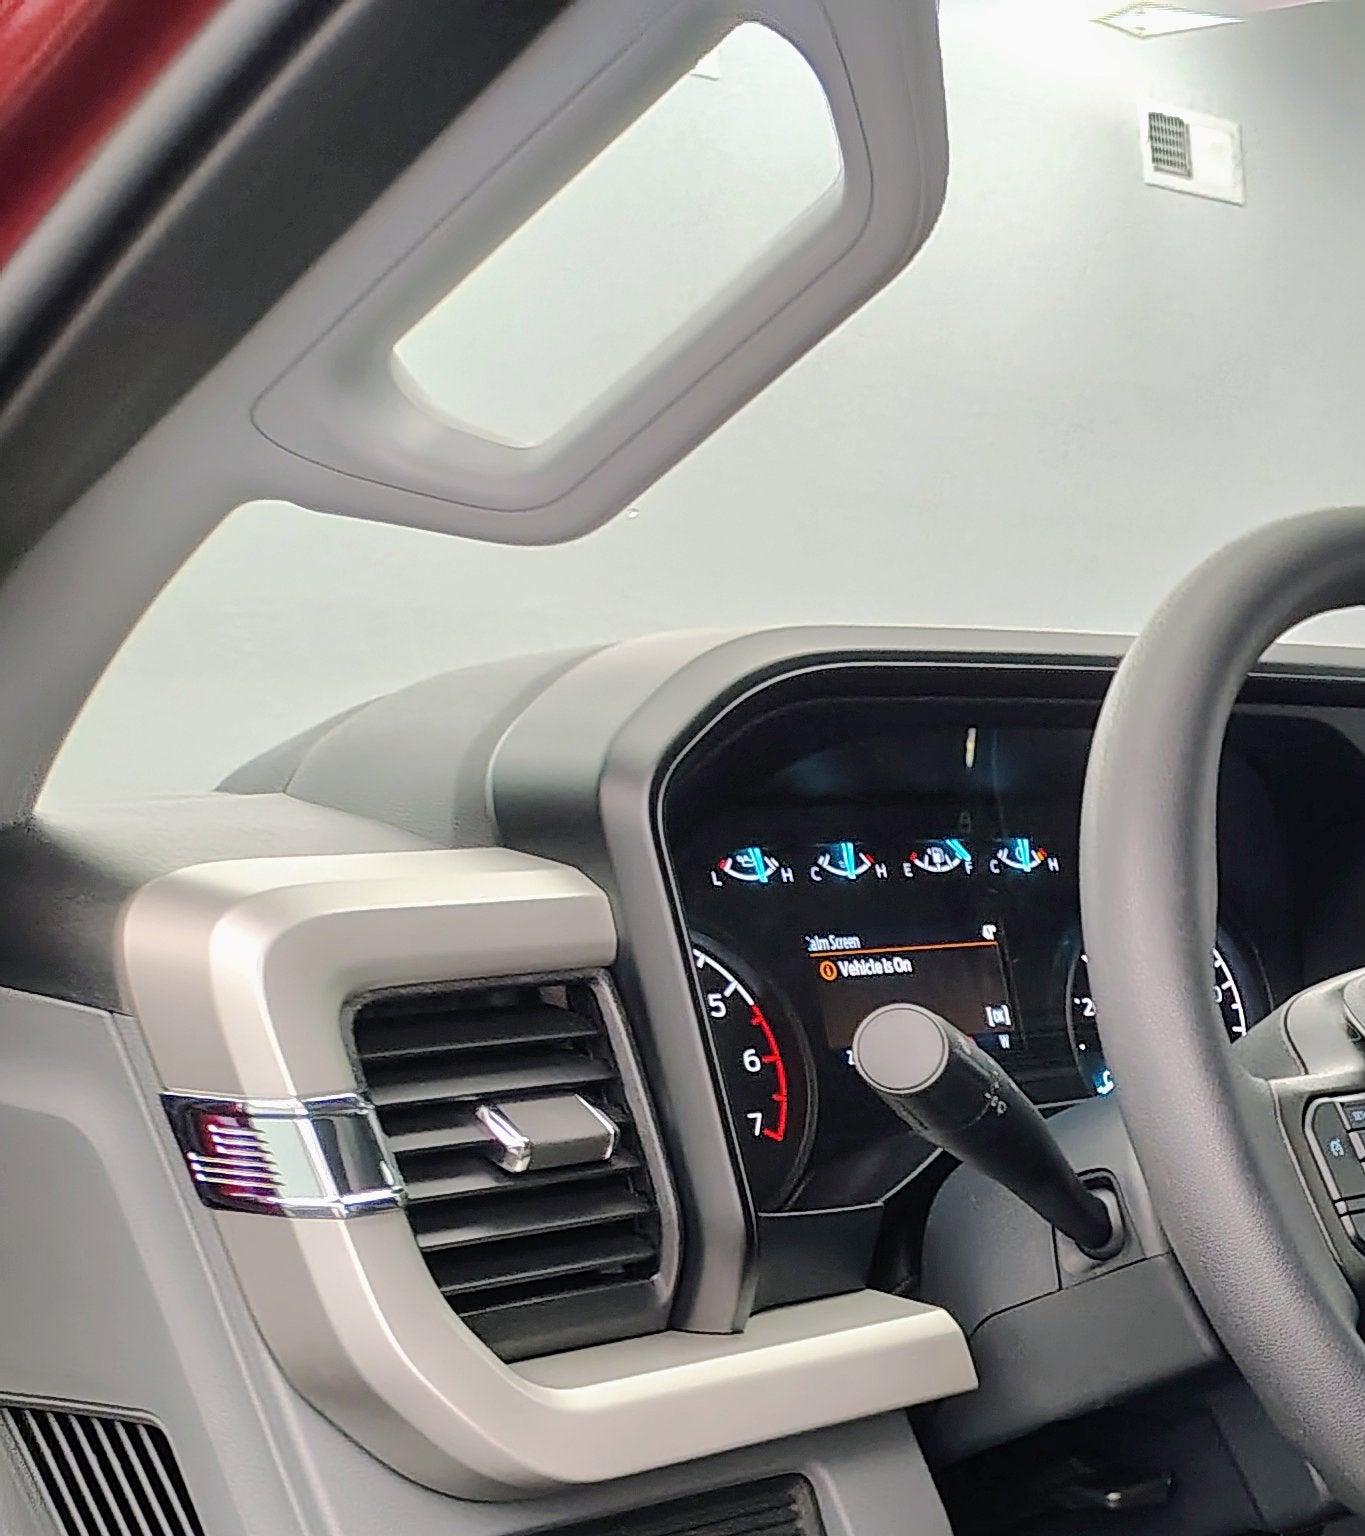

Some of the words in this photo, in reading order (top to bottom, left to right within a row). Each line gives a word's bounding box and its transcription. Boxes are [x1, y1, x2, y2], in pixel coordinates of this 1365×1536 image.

[876, 864, 889, 878] H
[903, 862, 914, 877] E
[965, 861, 974, 875] F
[990, 859, 1000, 873] C
[1047, 858, 1060, 872] H
[711, 871, 723, 887] L
[781, 867, 795, 883] H
[810, 866, 822, 881] C
[829, 935, 861, 950] Screen
[837, 960, 882, 977] Vehicle
[894, 957, 913, 973] On
[707, 992, 727, 1018] 5
[742, 1048, 762, 1073] 6
[746, 1112, 763, 1137] 7
